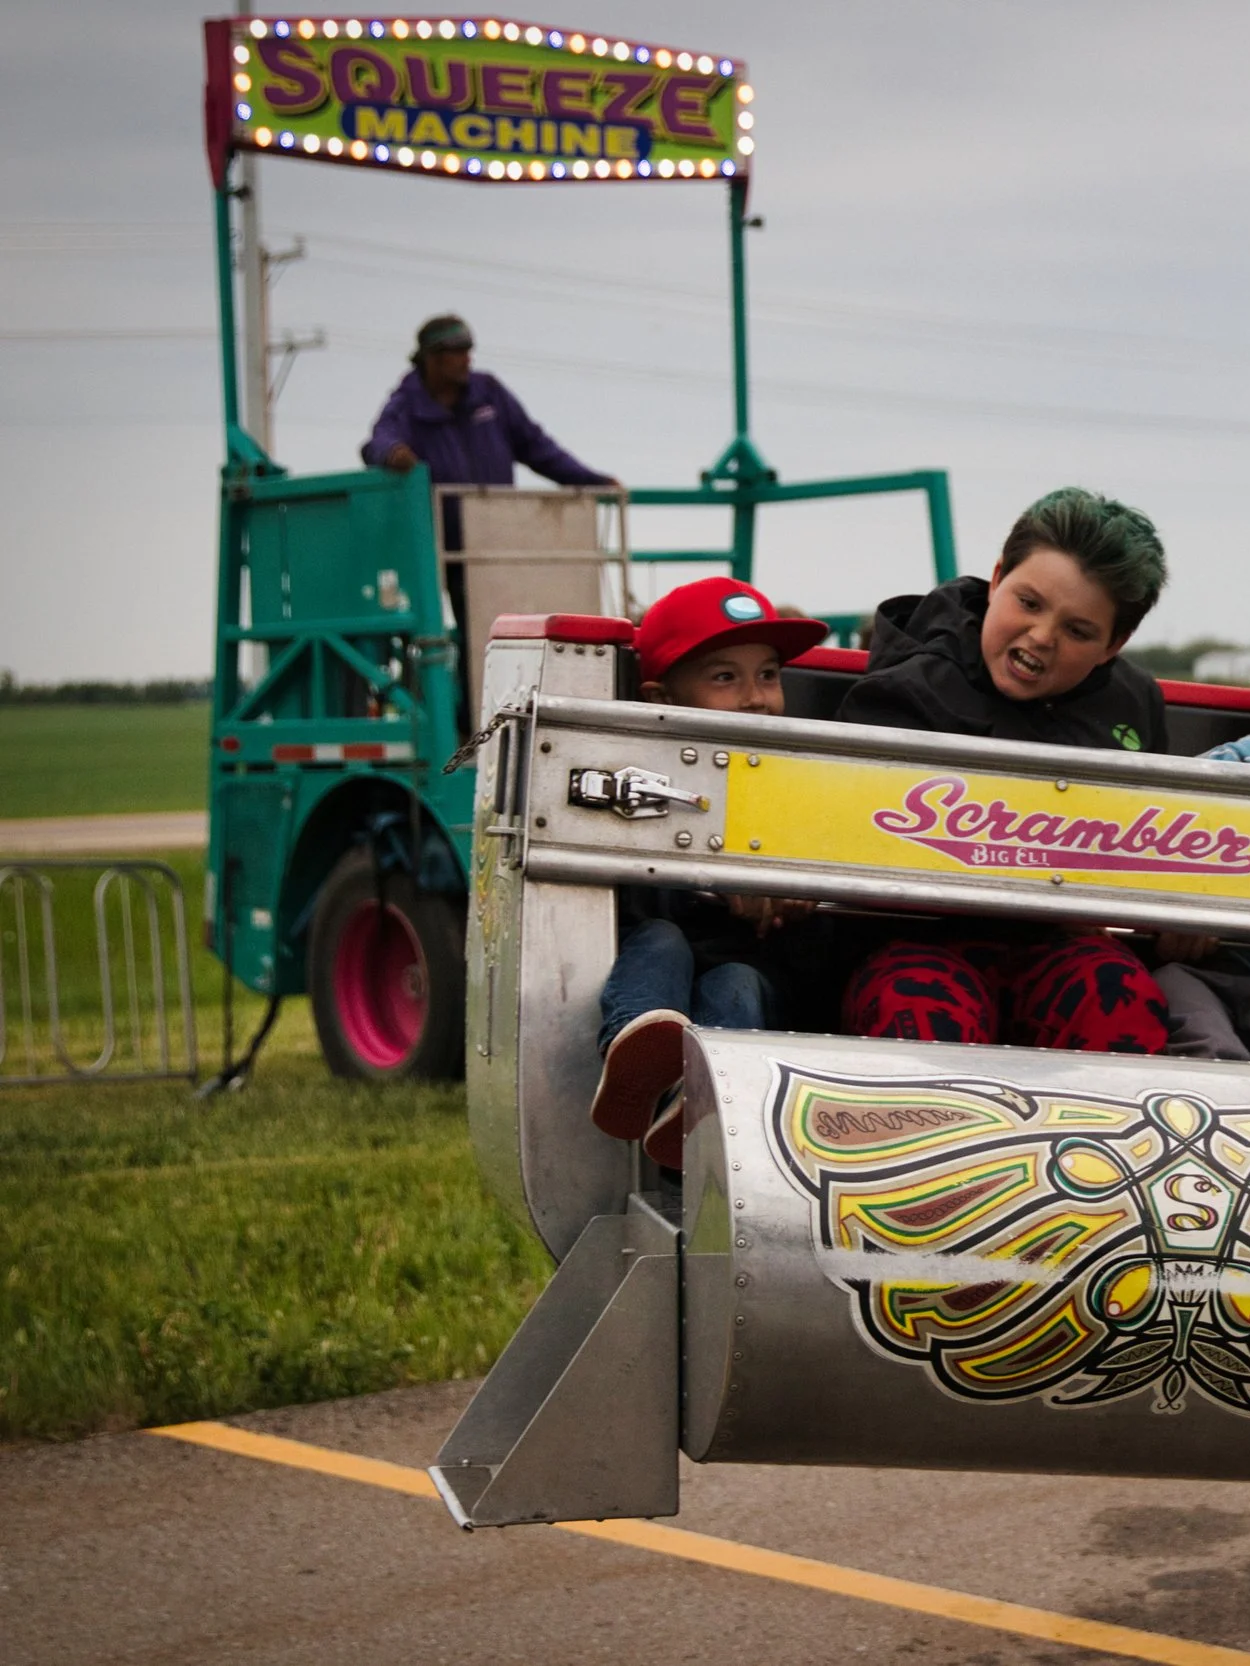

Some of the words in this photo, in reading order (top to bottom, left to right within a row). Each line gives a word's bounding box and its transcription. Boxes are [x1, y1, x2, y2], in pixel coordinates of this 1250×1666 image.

[256, 37, 725, 140] SQUEEZE
[353, 106, 639, 159] MACHINE
[1163, 1172, 1223, 1232] S
